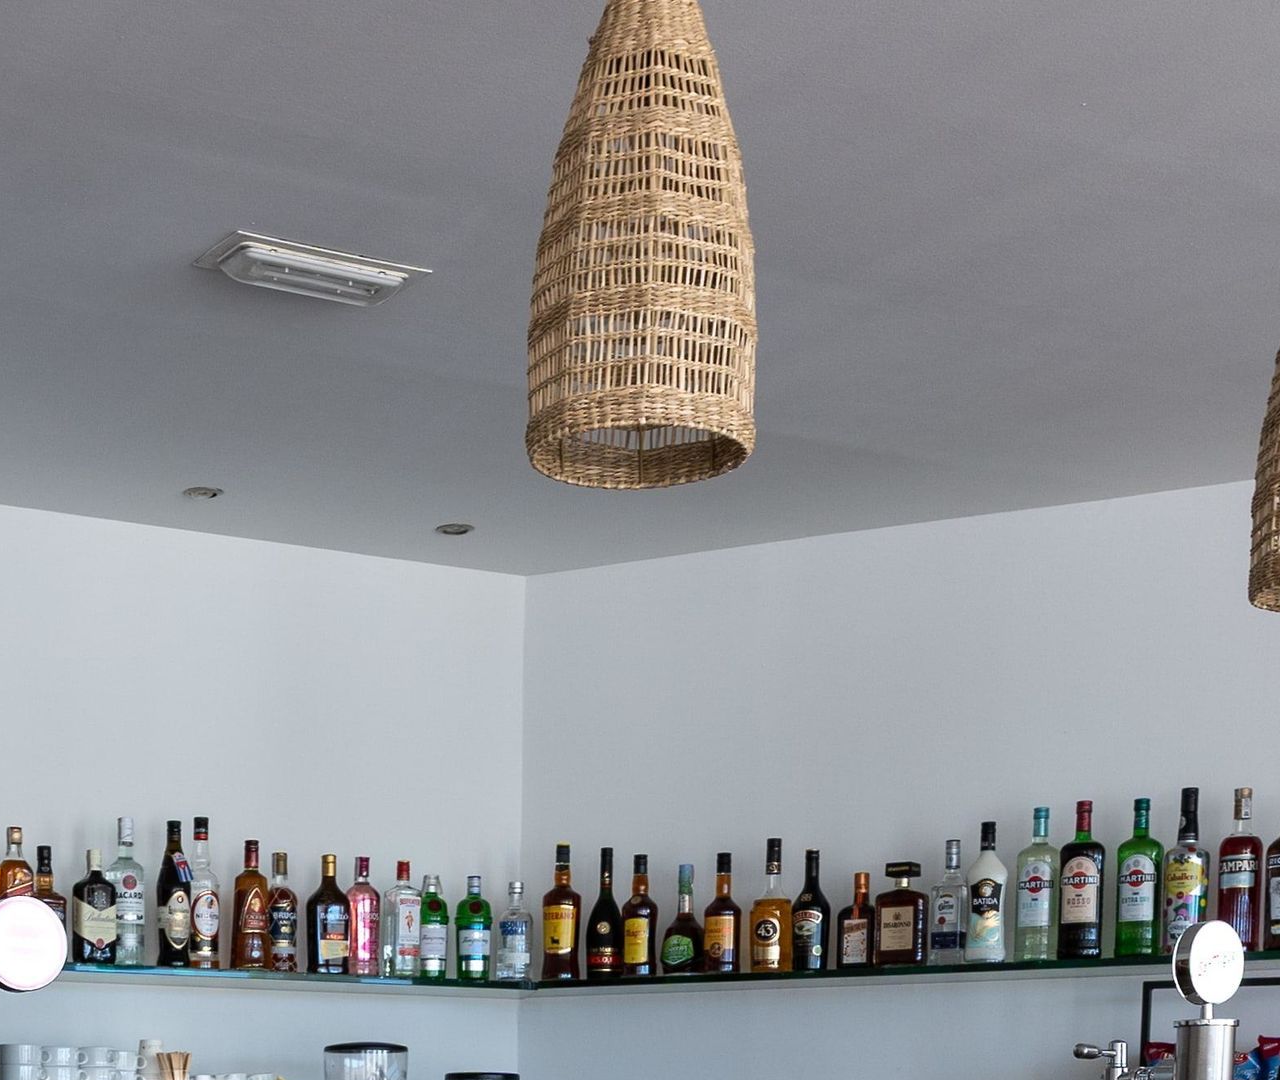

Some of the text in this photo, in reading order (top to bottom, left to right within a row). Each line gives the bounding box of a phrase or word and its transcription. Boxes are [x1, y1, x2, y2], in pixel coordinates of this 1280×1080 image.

[1063, 876, 1097, 885] MARTINI
[1120, 873, 1155, 883] MARTINI
[1019, 881, 1052, 889] MARTINI
[973, 897, 998, 905] BATIDA
[1066, 897, 1091, 905] ROSSO
[1122, 896, 1138, 904] EXTRA
[758, 924, 773, 937] 43
